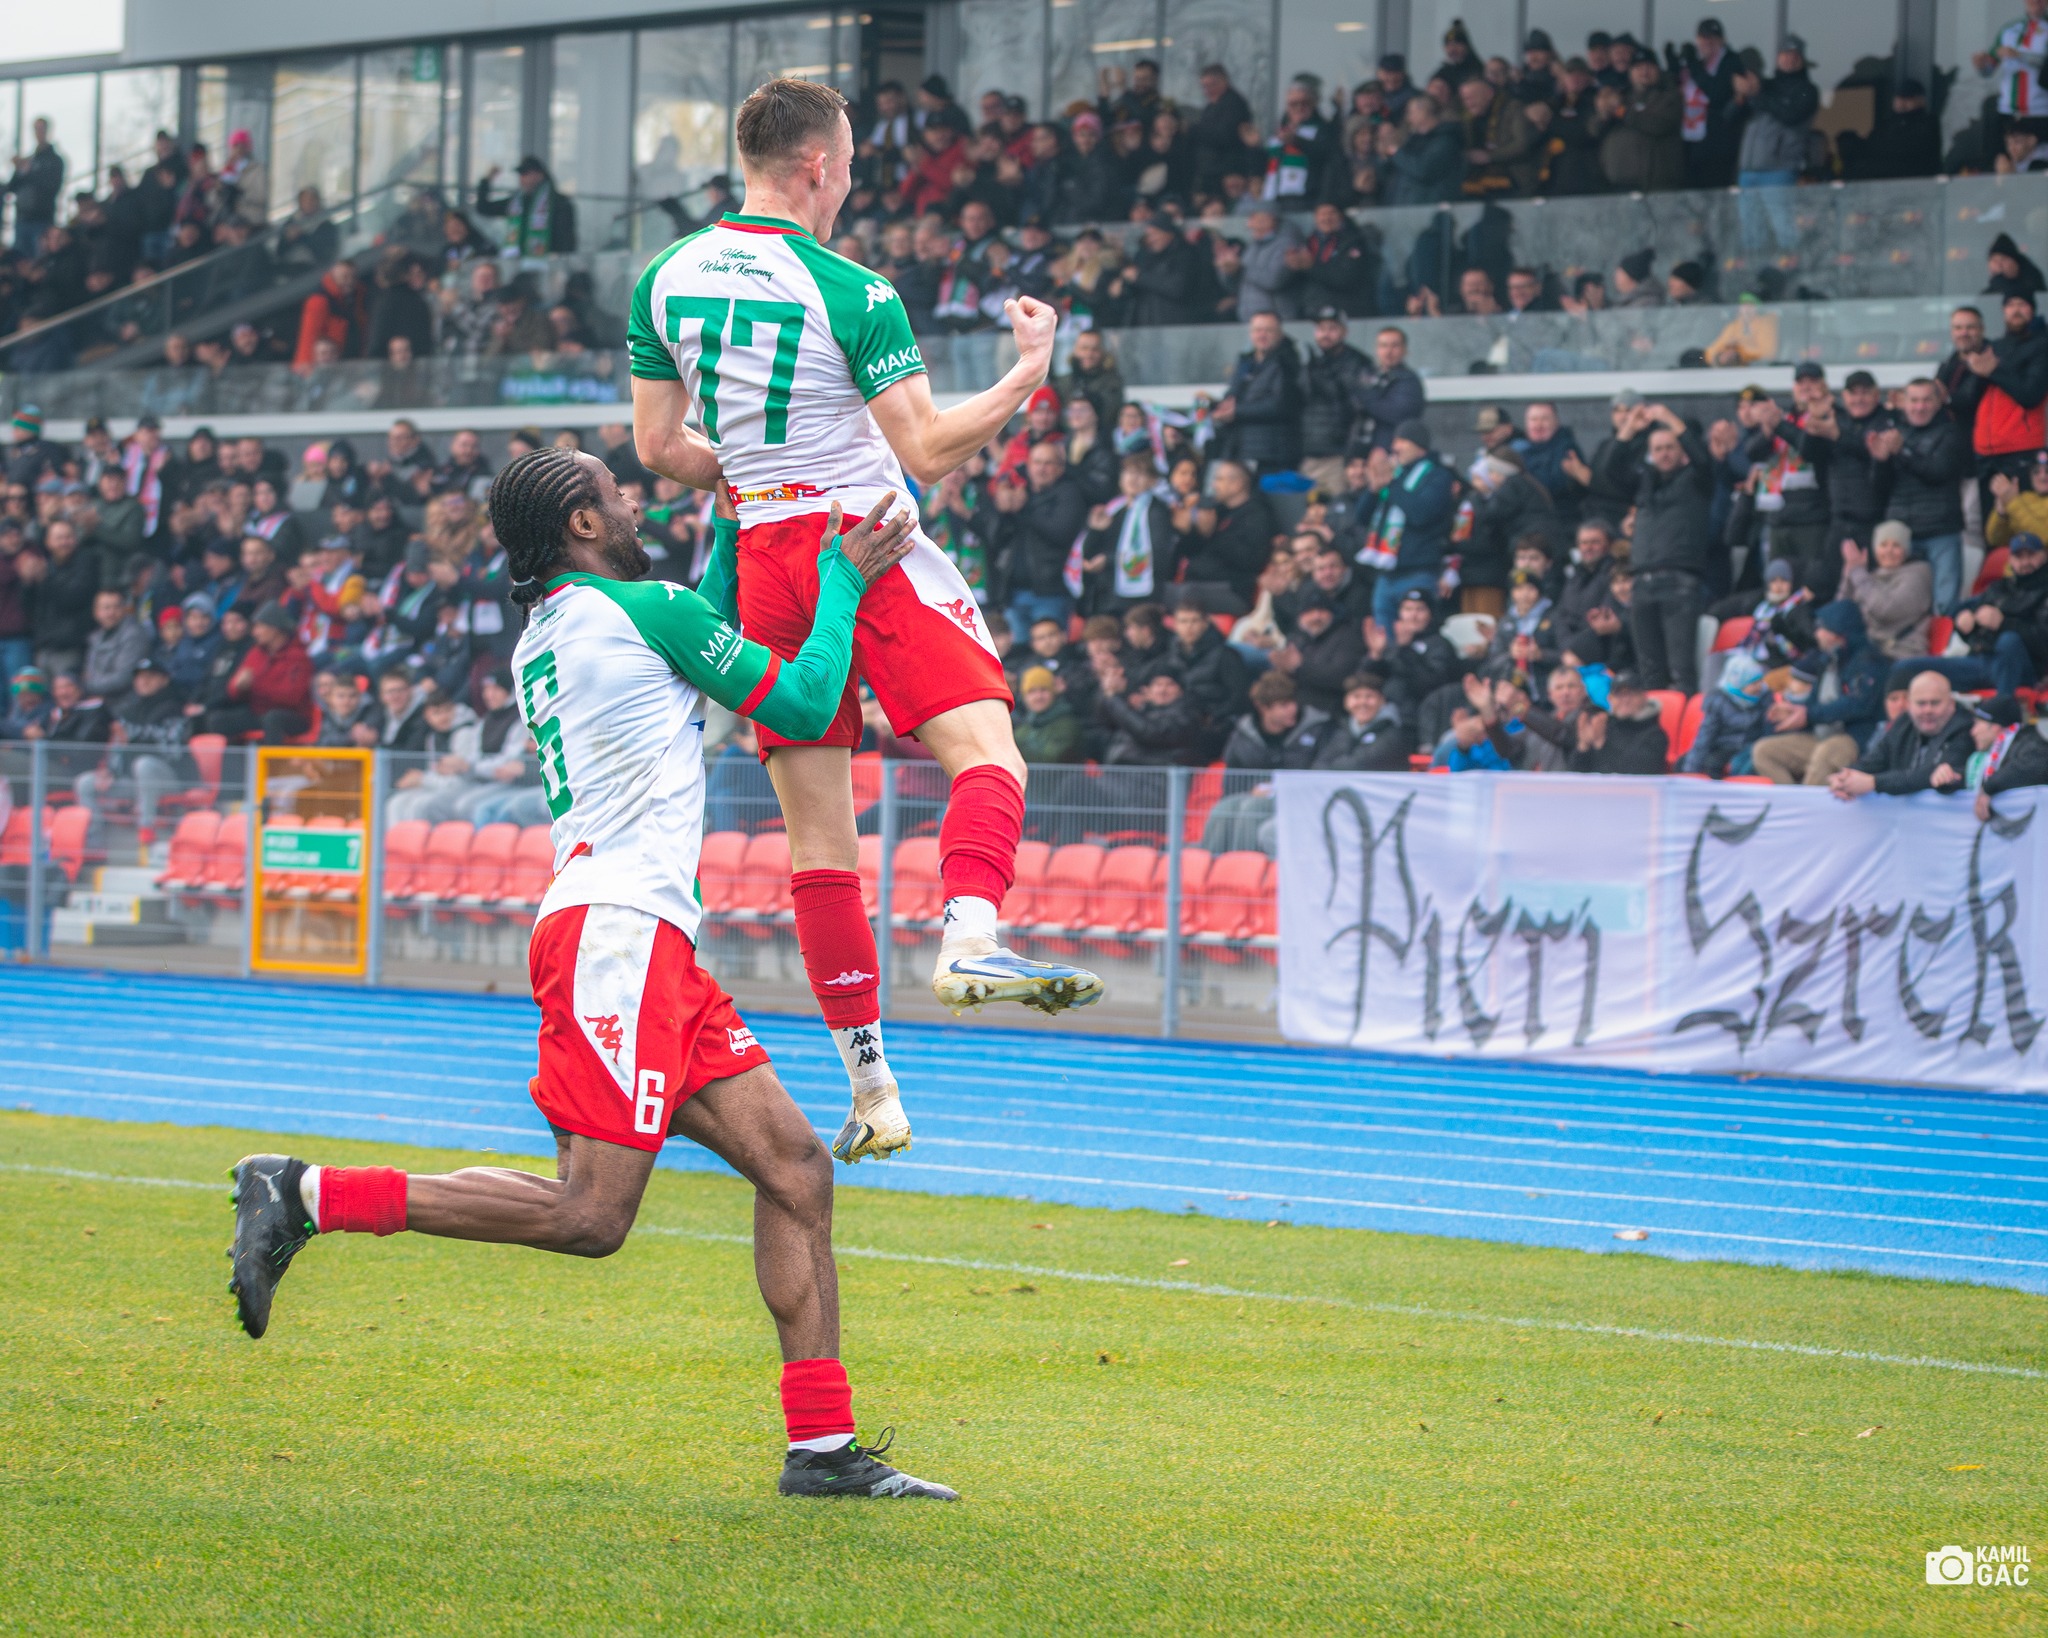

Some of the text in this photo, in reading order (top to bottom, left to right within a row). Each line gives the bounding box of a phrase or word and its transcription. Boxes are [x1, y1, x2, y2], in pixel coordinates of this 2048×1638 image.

[665, 296, 806, 444] 77
[867, 344, 922, 380] MAKO
[521, 649, 575, 821] 6
[634, 1068, 666, 1135] 6
